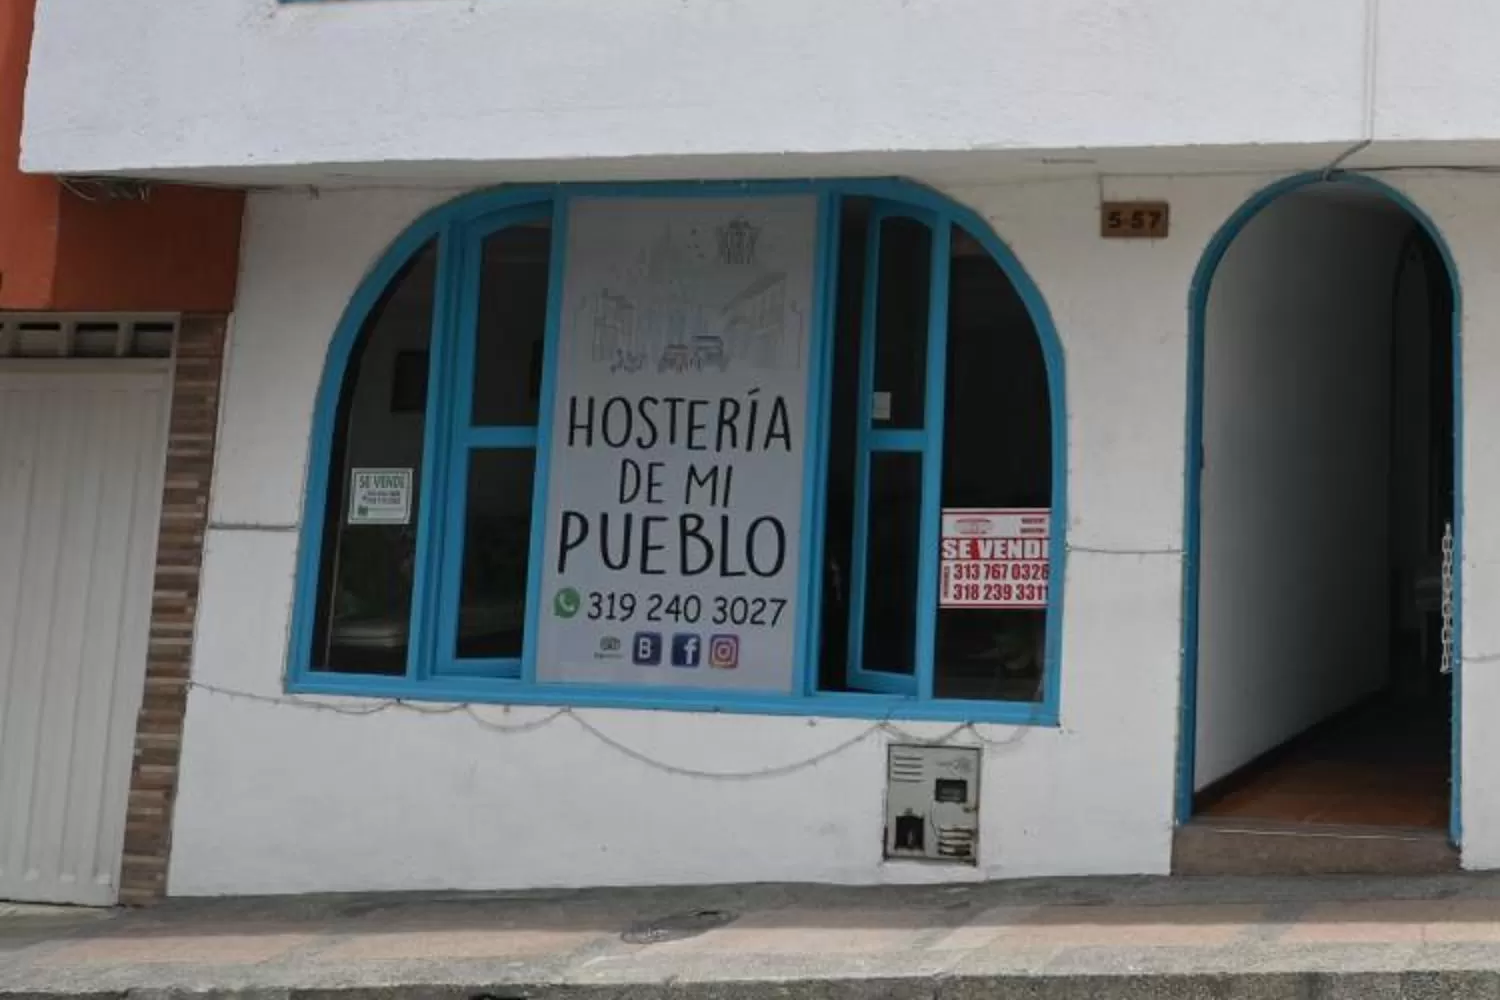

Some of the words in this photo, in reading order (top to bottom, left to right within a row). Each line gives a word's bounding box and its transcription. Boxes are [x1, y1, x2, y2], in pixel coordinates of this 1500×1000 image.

[568, 387, 791, 452] HOSTERÍA
[619, 458, 665, 504] DE
[685, 464, 733, 508] MI
[557, 511, 786, 577] PUEBLO
[942, 539, 973, 560] SE
[953, 563, 980, 581] 313
[983, 563, 1008, 581] 767
[587, 592, 637, 621] 319
[647, 594, 701, 624] 240
[712, 596, 787, 628] 3027
[953, 583, 980, 601] 318
[983, 583, 1012, 601] 239
